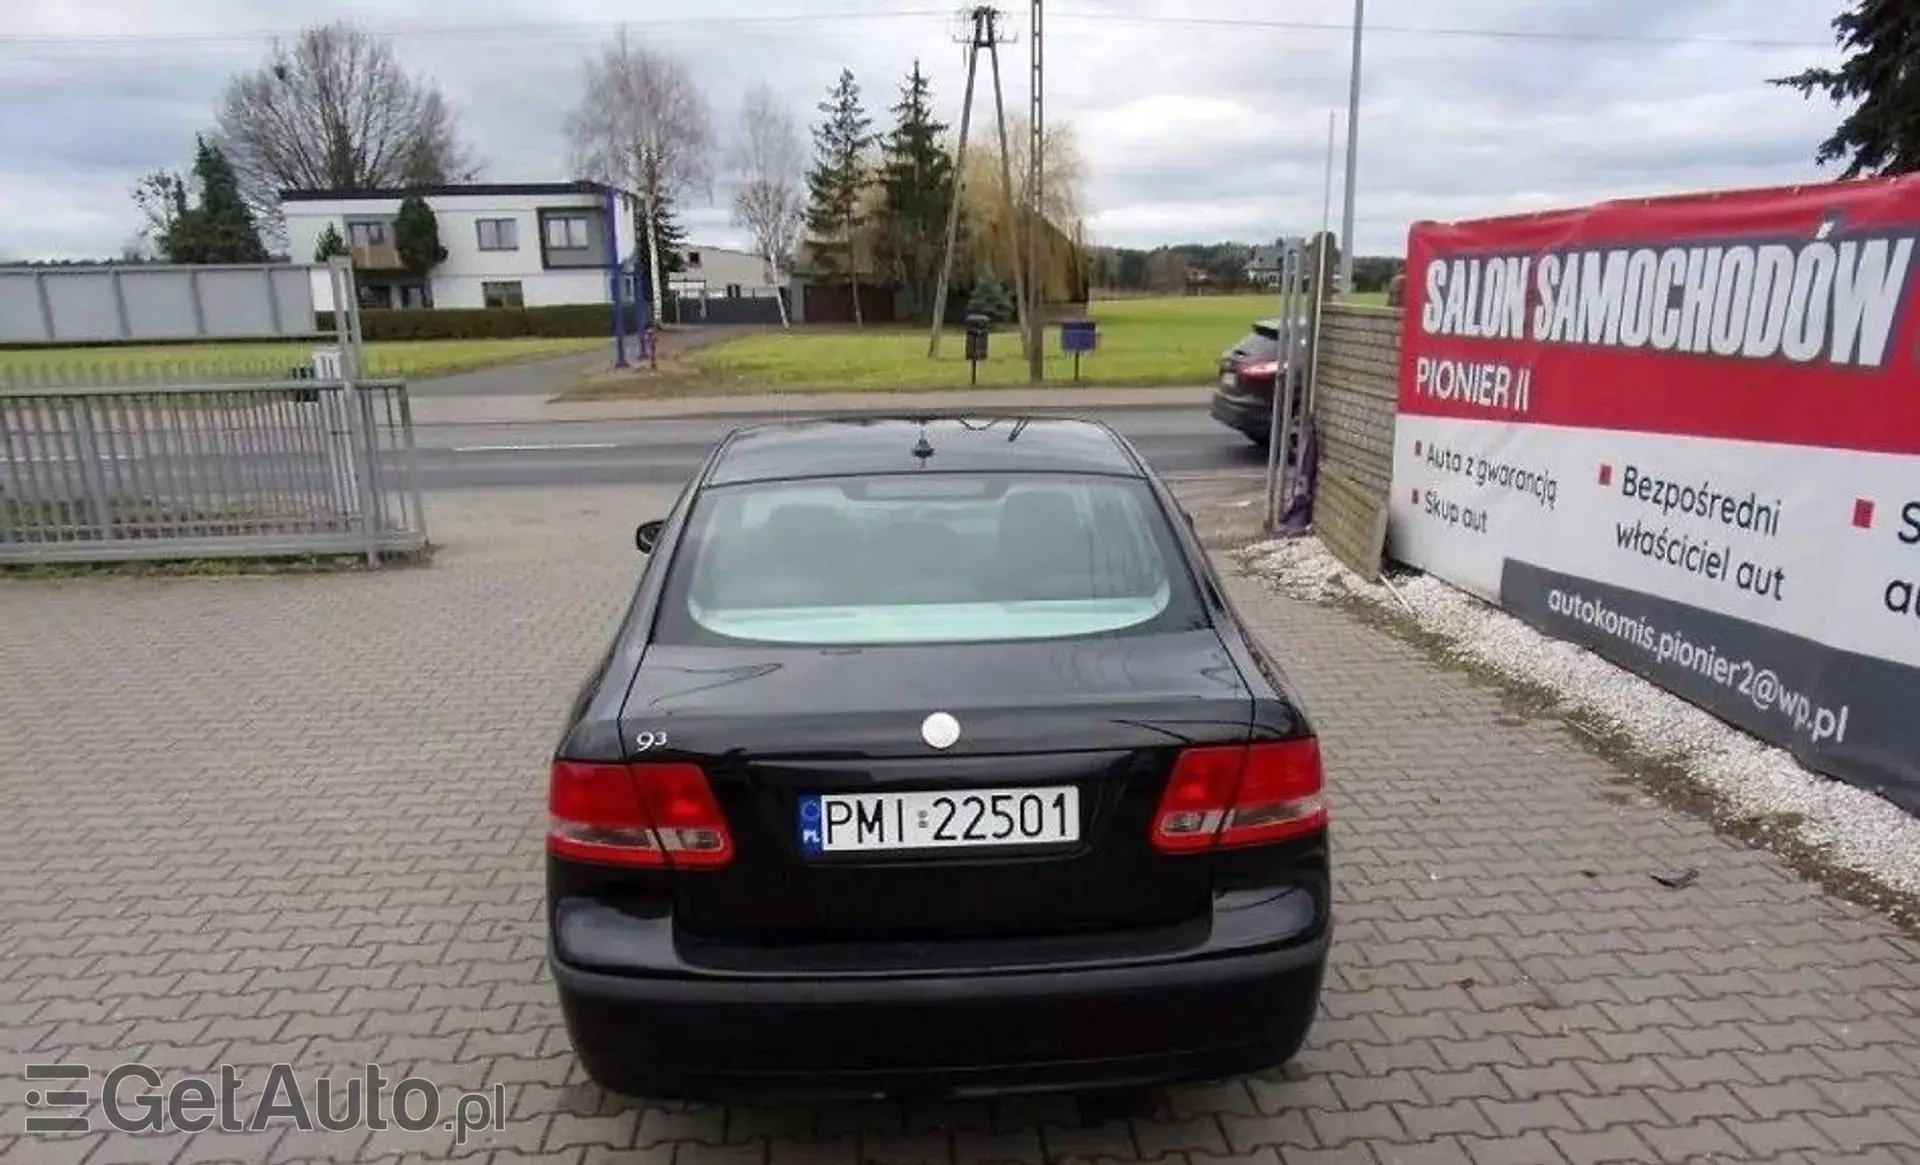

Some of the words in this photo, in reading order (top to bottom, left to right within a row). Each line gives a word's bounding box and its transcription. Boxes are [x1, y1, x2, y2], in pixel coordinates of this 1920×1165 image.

[1422, 256, 1531, 339] SALON
[1532, 221, 1915, 366] SAMOCHODÓW
[1416, 357, 1511, 409] PIONIER
[1426, 443, 1461, 472] Auto
[1465, 458, 1473, 477] z
[1476, 460, 1558, 510] gwarancją
[1622, 466, 1781, 536] Bezpośredni
[1425, 489, 1459, 527] Skup
[1462, 505, 1488, 533] aut
[1616, 520, 1730, 582] właściciel
[1736, 560, 1785, 601] aut
[1548, 586, 1849, 744] autokomis.pionier2@wp.pl
[826, 798, 904, 845] PMI
[932, 792, 1067, 842] 22501
